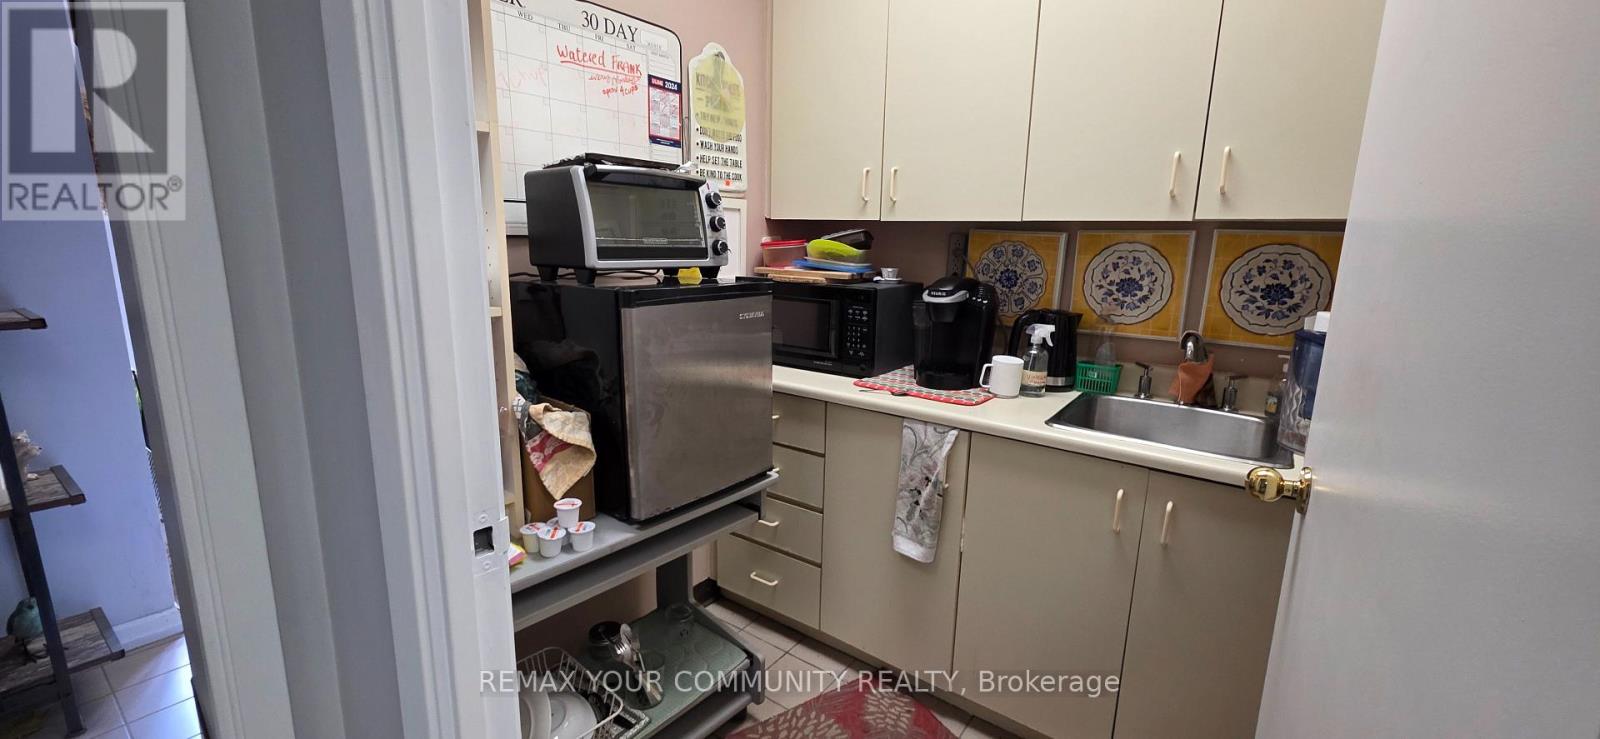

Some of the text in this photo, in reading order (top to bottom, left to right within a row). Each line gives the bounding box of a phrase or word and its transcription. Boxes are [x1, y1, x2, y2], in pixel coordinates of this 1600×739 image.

[517, 10, 534, 21] WED
[581, 10, 639, 42] 30 DAY
[556, 44, 606, 68] Watered
[664, 81, 678, 91] 2024
[699, 140, 739, 155] WASH YOUR HANDS
[699, 154, 743, 169] HELP SET THE TABLE
[699, 168, 743, 182] BE KIND TO THE COOK
